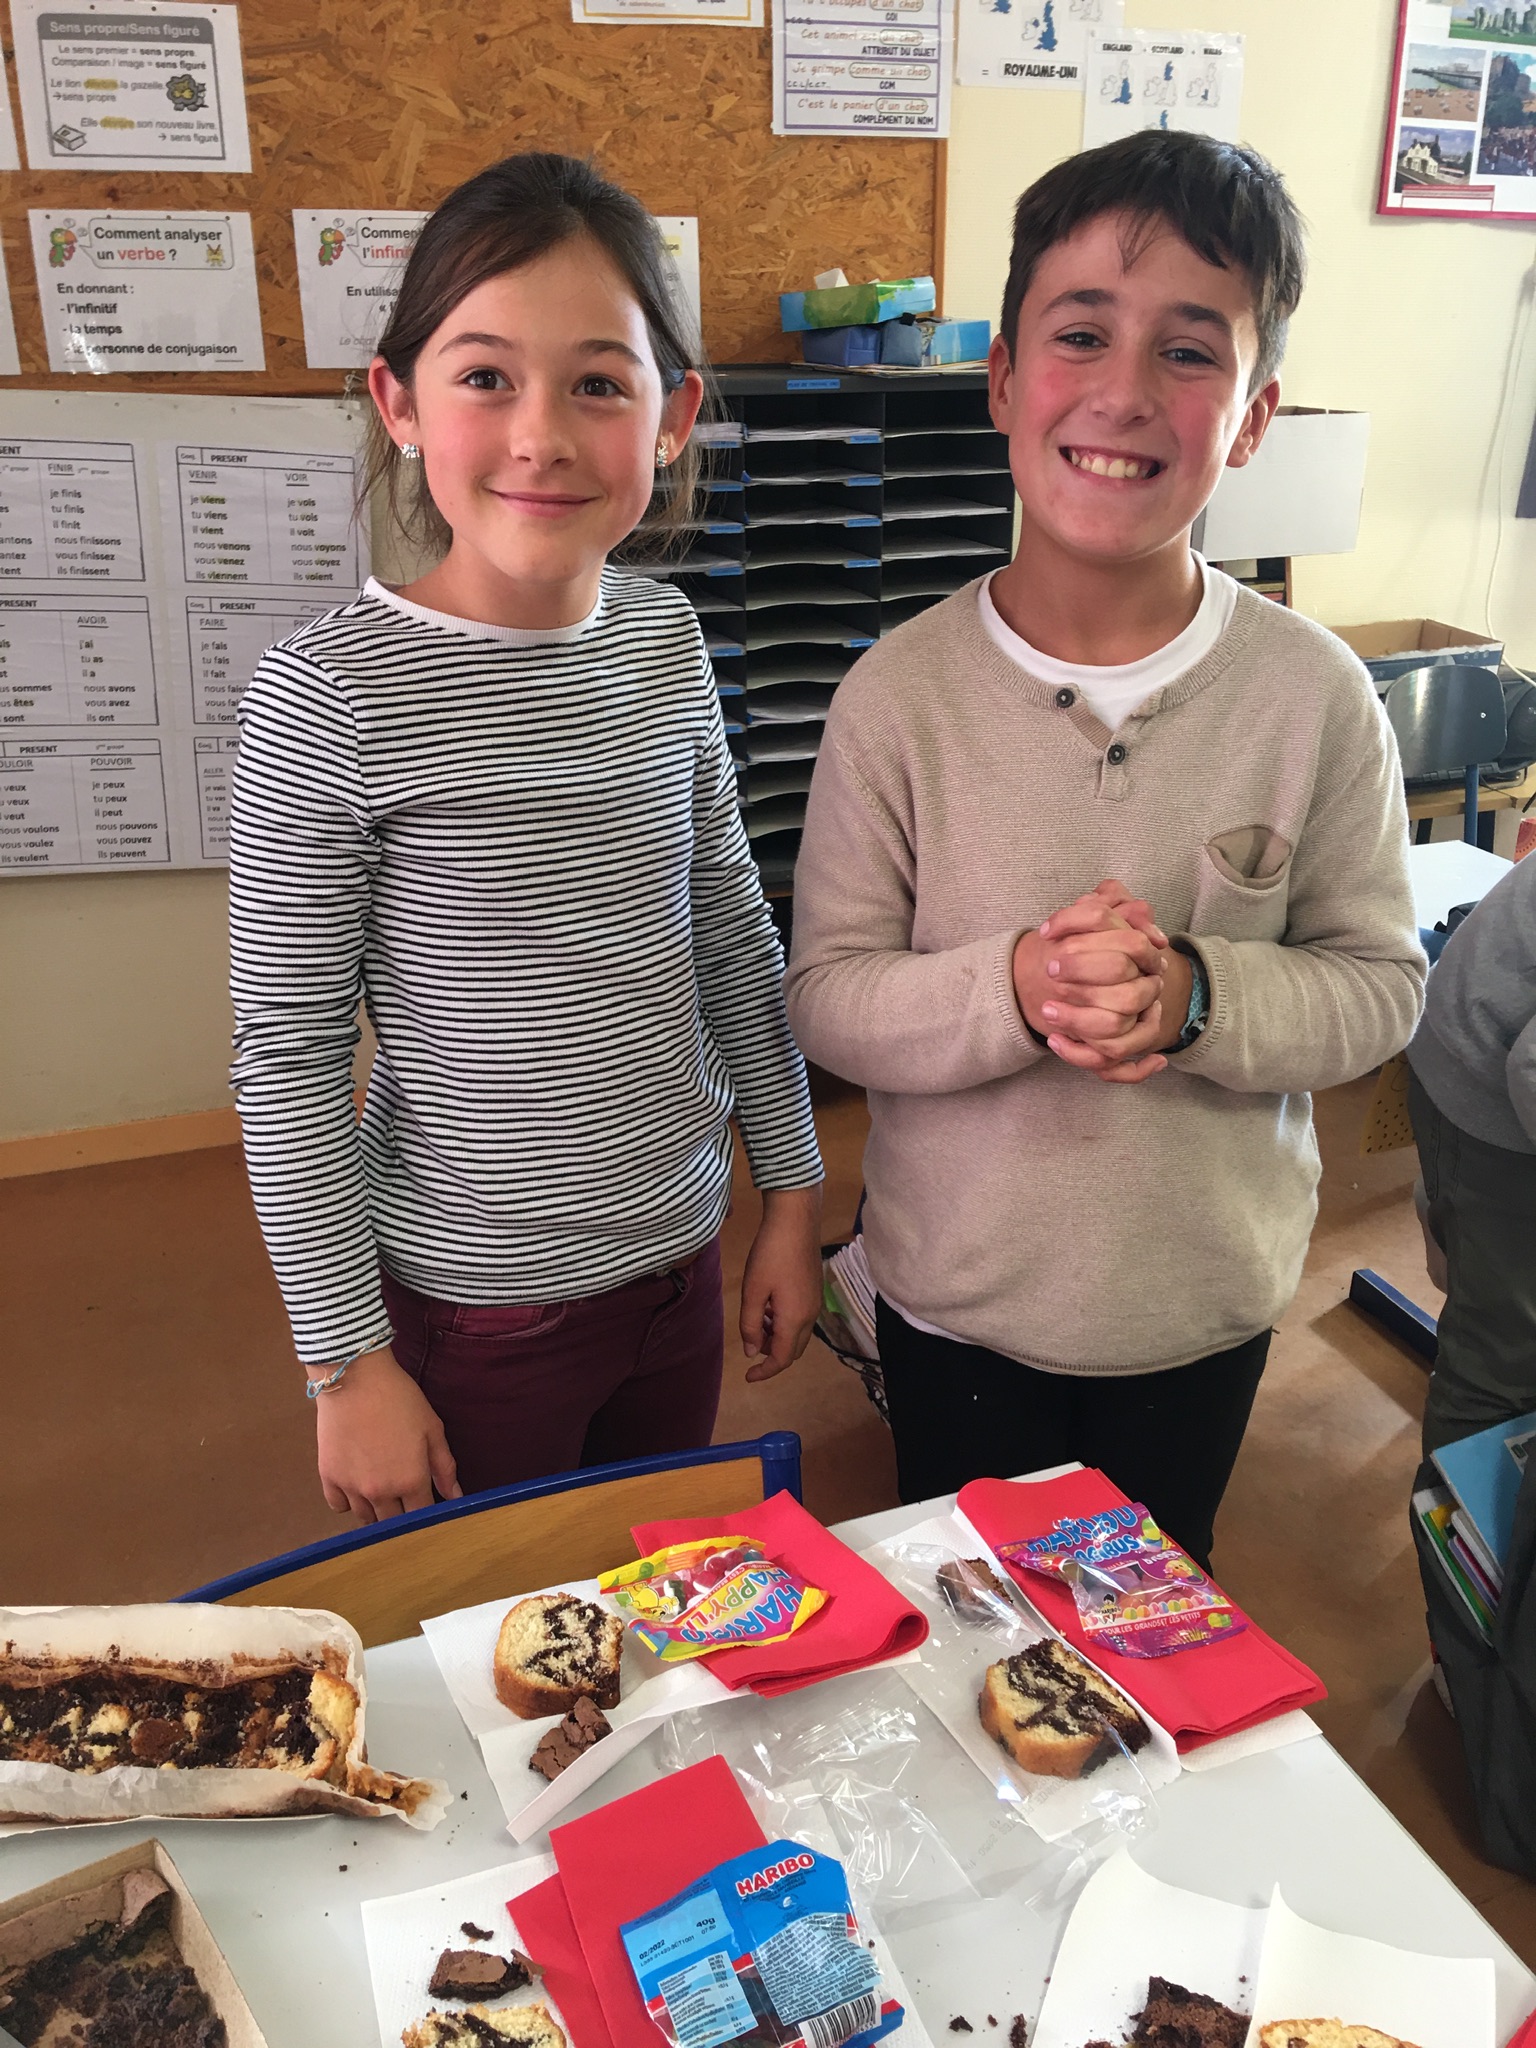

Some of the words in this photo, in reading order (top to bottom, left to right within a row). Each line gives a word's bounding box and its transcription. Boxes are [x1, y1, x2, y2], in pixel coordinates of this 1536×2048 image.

[50, 22, 80, 33] Sens
[84, 23, 160, 35] propre/Sens
[163, 24, 200, 38] figuré
[862, 46, 898, 55] ATTRIBUT
[901, 47, 910, 55] DU
[913, 48, 936, 56] SUJET
[1103, 44, 1132, 52] ENGLAND
[1151, 46, 1184, 54] SCOTLAND
[52, 57, 110, 67] Comparaison
[1004, 63, 1077, 79] ROYAUME-UNI
[880, 81, 895, 89] CCM
[905, 116, 915, 124] DU
[918, 116, 933, 124] NOM
[94, 227, 161, 240] Comment
[165, 229, 222, 243] analyser
[98, 250, 114, 260] un
[118, 247, 166, 261] verbe
[57, 284, 73, 293] En
[77, 284, 128, 294] donnant
[347, 287, 361, 296] En
[67, 303, 117, 314] l'infinitif
[84, 325, 122, 336] temps
[148, 344, 162, 353] de
[166, 344, 237, 356] conjugaison
[211, 455, 248, 463] PRESENT
[48, 464, 73, 472] FINIR
[189, 470, 217, 478] VENIR
[285, 473, 307, 481] VOIR
[50, 490, 59, 499] je
[62, 490, 82, 498] finis
[64, 505, 85, 513] finis
[204, 512, 227, 520] viens
[61, 521, 80, 529] finit
[201, 527, 224, 535] vient
[80, 537, 121, 545] finissons
[217, 542, 250, 551] venons
[315, 544, 346, 553] voyons
[81, 552, 115, 560] finissez
[315, 559, 340, 567] voyez
[70, 566, 110, 575] finissent
[208, 573, 248, 581] viennent
[77, 616, 107, 624] AVOIR
[200, 619, 224, 627] FAIRE
[212, 642, 227, 650] fais
[218, 714, 236, 722] font
[20, 745, 57, 753] PRESENT
[0, 760, 33, 768] OULOIR
[91, 758, 132, 766] POUVOIR
[106, 796, 127, 804] peux
[23, 826, 60, 834] voulons
[119, 822, 158, 831] pouvons
[24, 840, 53, 848] voulez
[120, 837, 152, 846] pouvez
[14, 854, 49, 862] veulent
[110, 850, 147, 859] peuvent
[683, 1567, 792, 1633] HAPPY'LI
[1135, 1621, 1160, 1630] GRANDS
[1170, 1616, 1180, 1624] LES
[1180, 1612, 1201, 1620] PETITS
[735, 1853, 815, 1897] HARIBO
[696, 1917, 715, 1928] 40g
[639, 1939, 666, 1960] 02/2022
